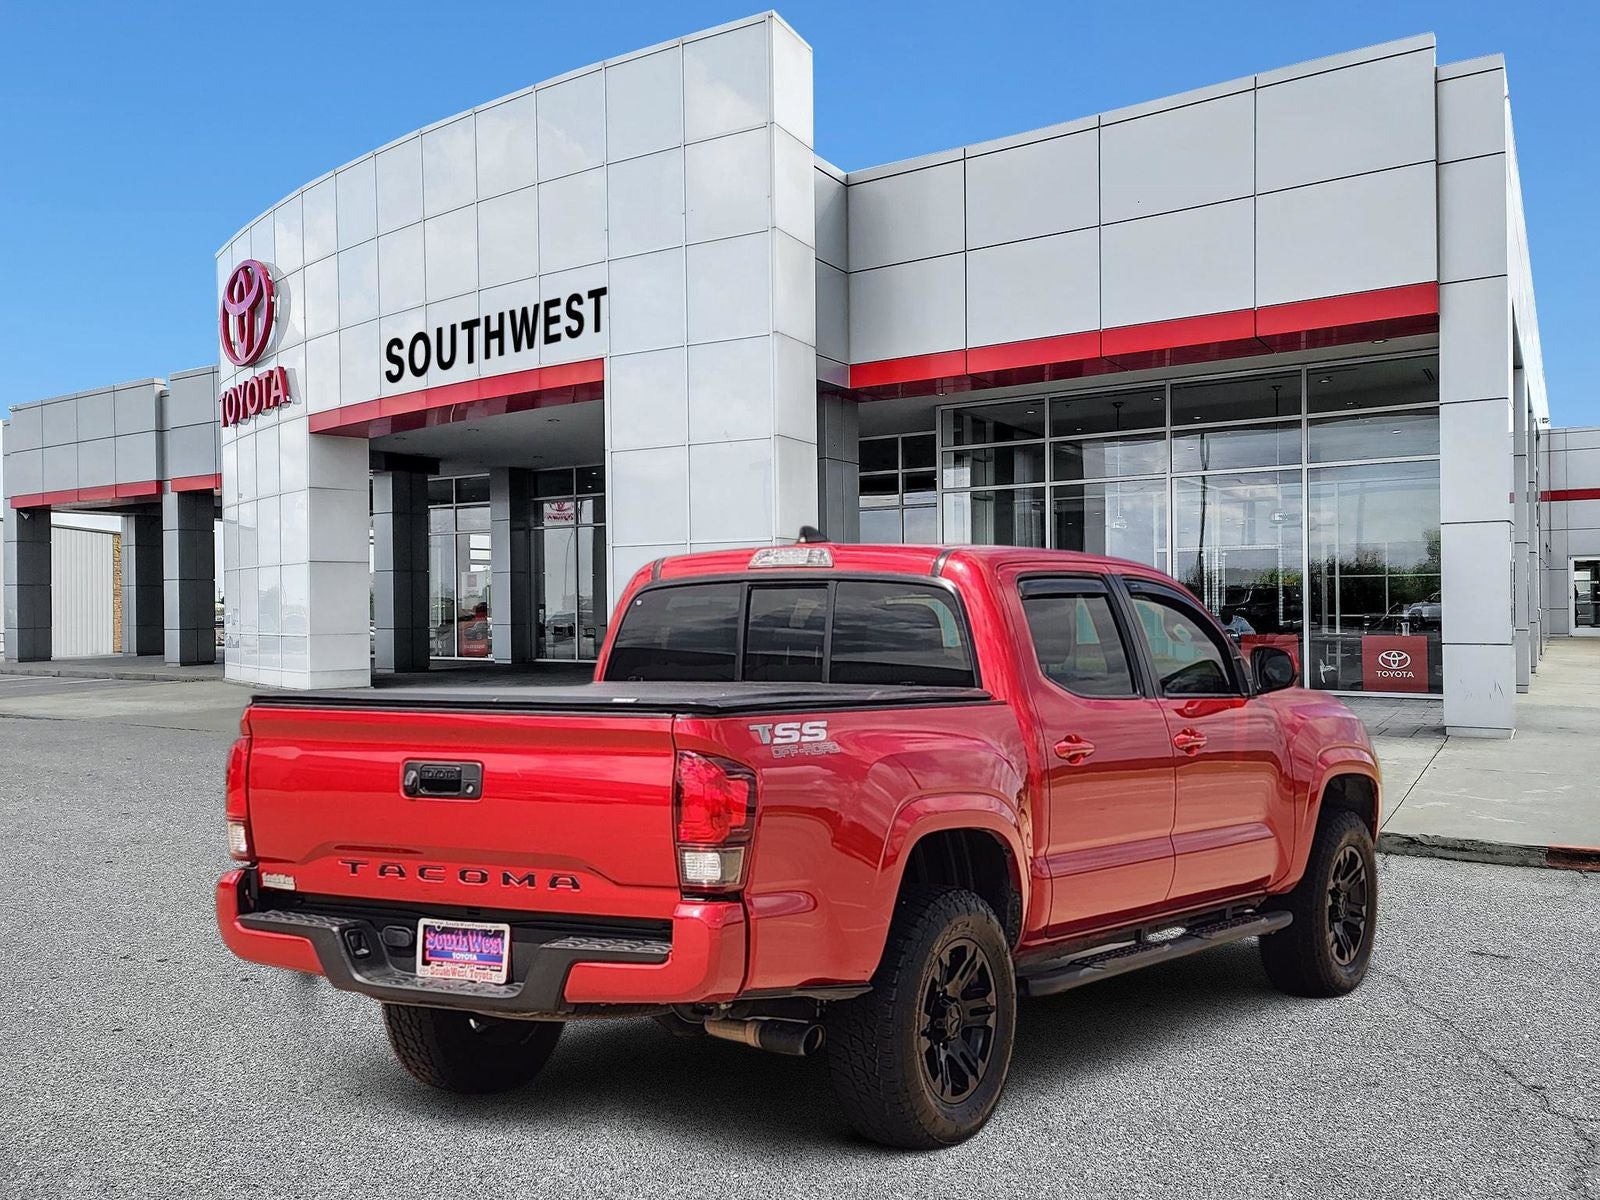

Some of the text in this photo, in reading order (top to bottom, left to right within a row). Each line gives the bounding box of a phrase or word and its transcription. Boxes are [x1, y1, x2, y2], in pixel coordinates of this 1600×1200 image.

[385, 286, 608, 384] SOUTHWEST
[217, 366, 290, 428] TOYOTA
[1376, 670, 1415, 678] TOYOTA
[748, 720, 828, 745] TSS
[338, 859, 582, 892] TACOMA
[451, 952, 478, 961] TOYOTA
